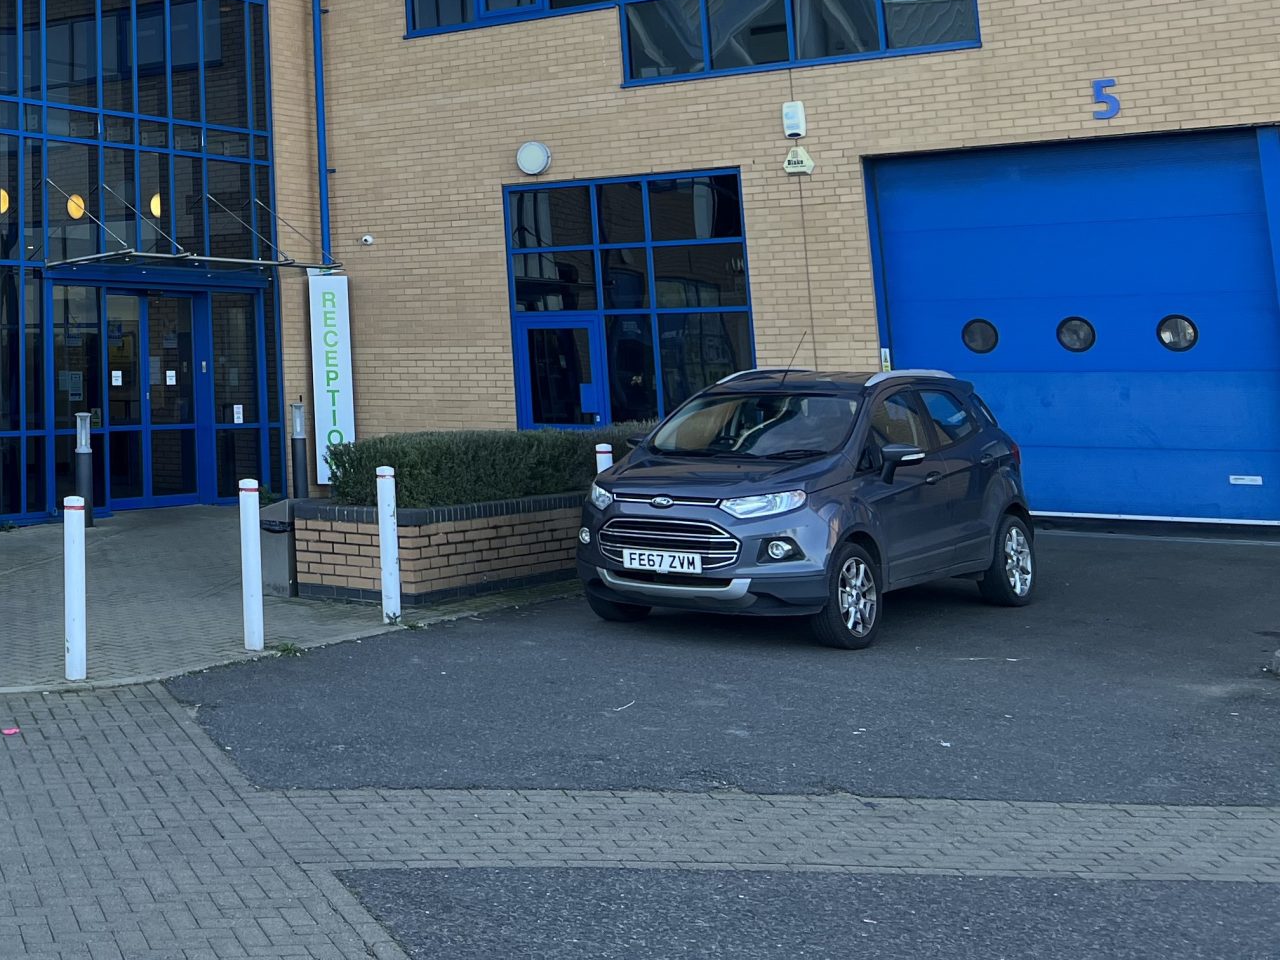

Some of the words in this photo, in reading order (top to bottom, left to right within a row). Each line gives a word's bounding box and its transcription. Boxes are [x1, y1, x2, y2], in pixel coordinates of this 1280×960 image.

[1092, 78, 1120, 120] 5
[322, 291, 345, 467] RECEPTIO
[628, 552, 664, 568] FE67
[668, 554, 696, 570] ZVM
